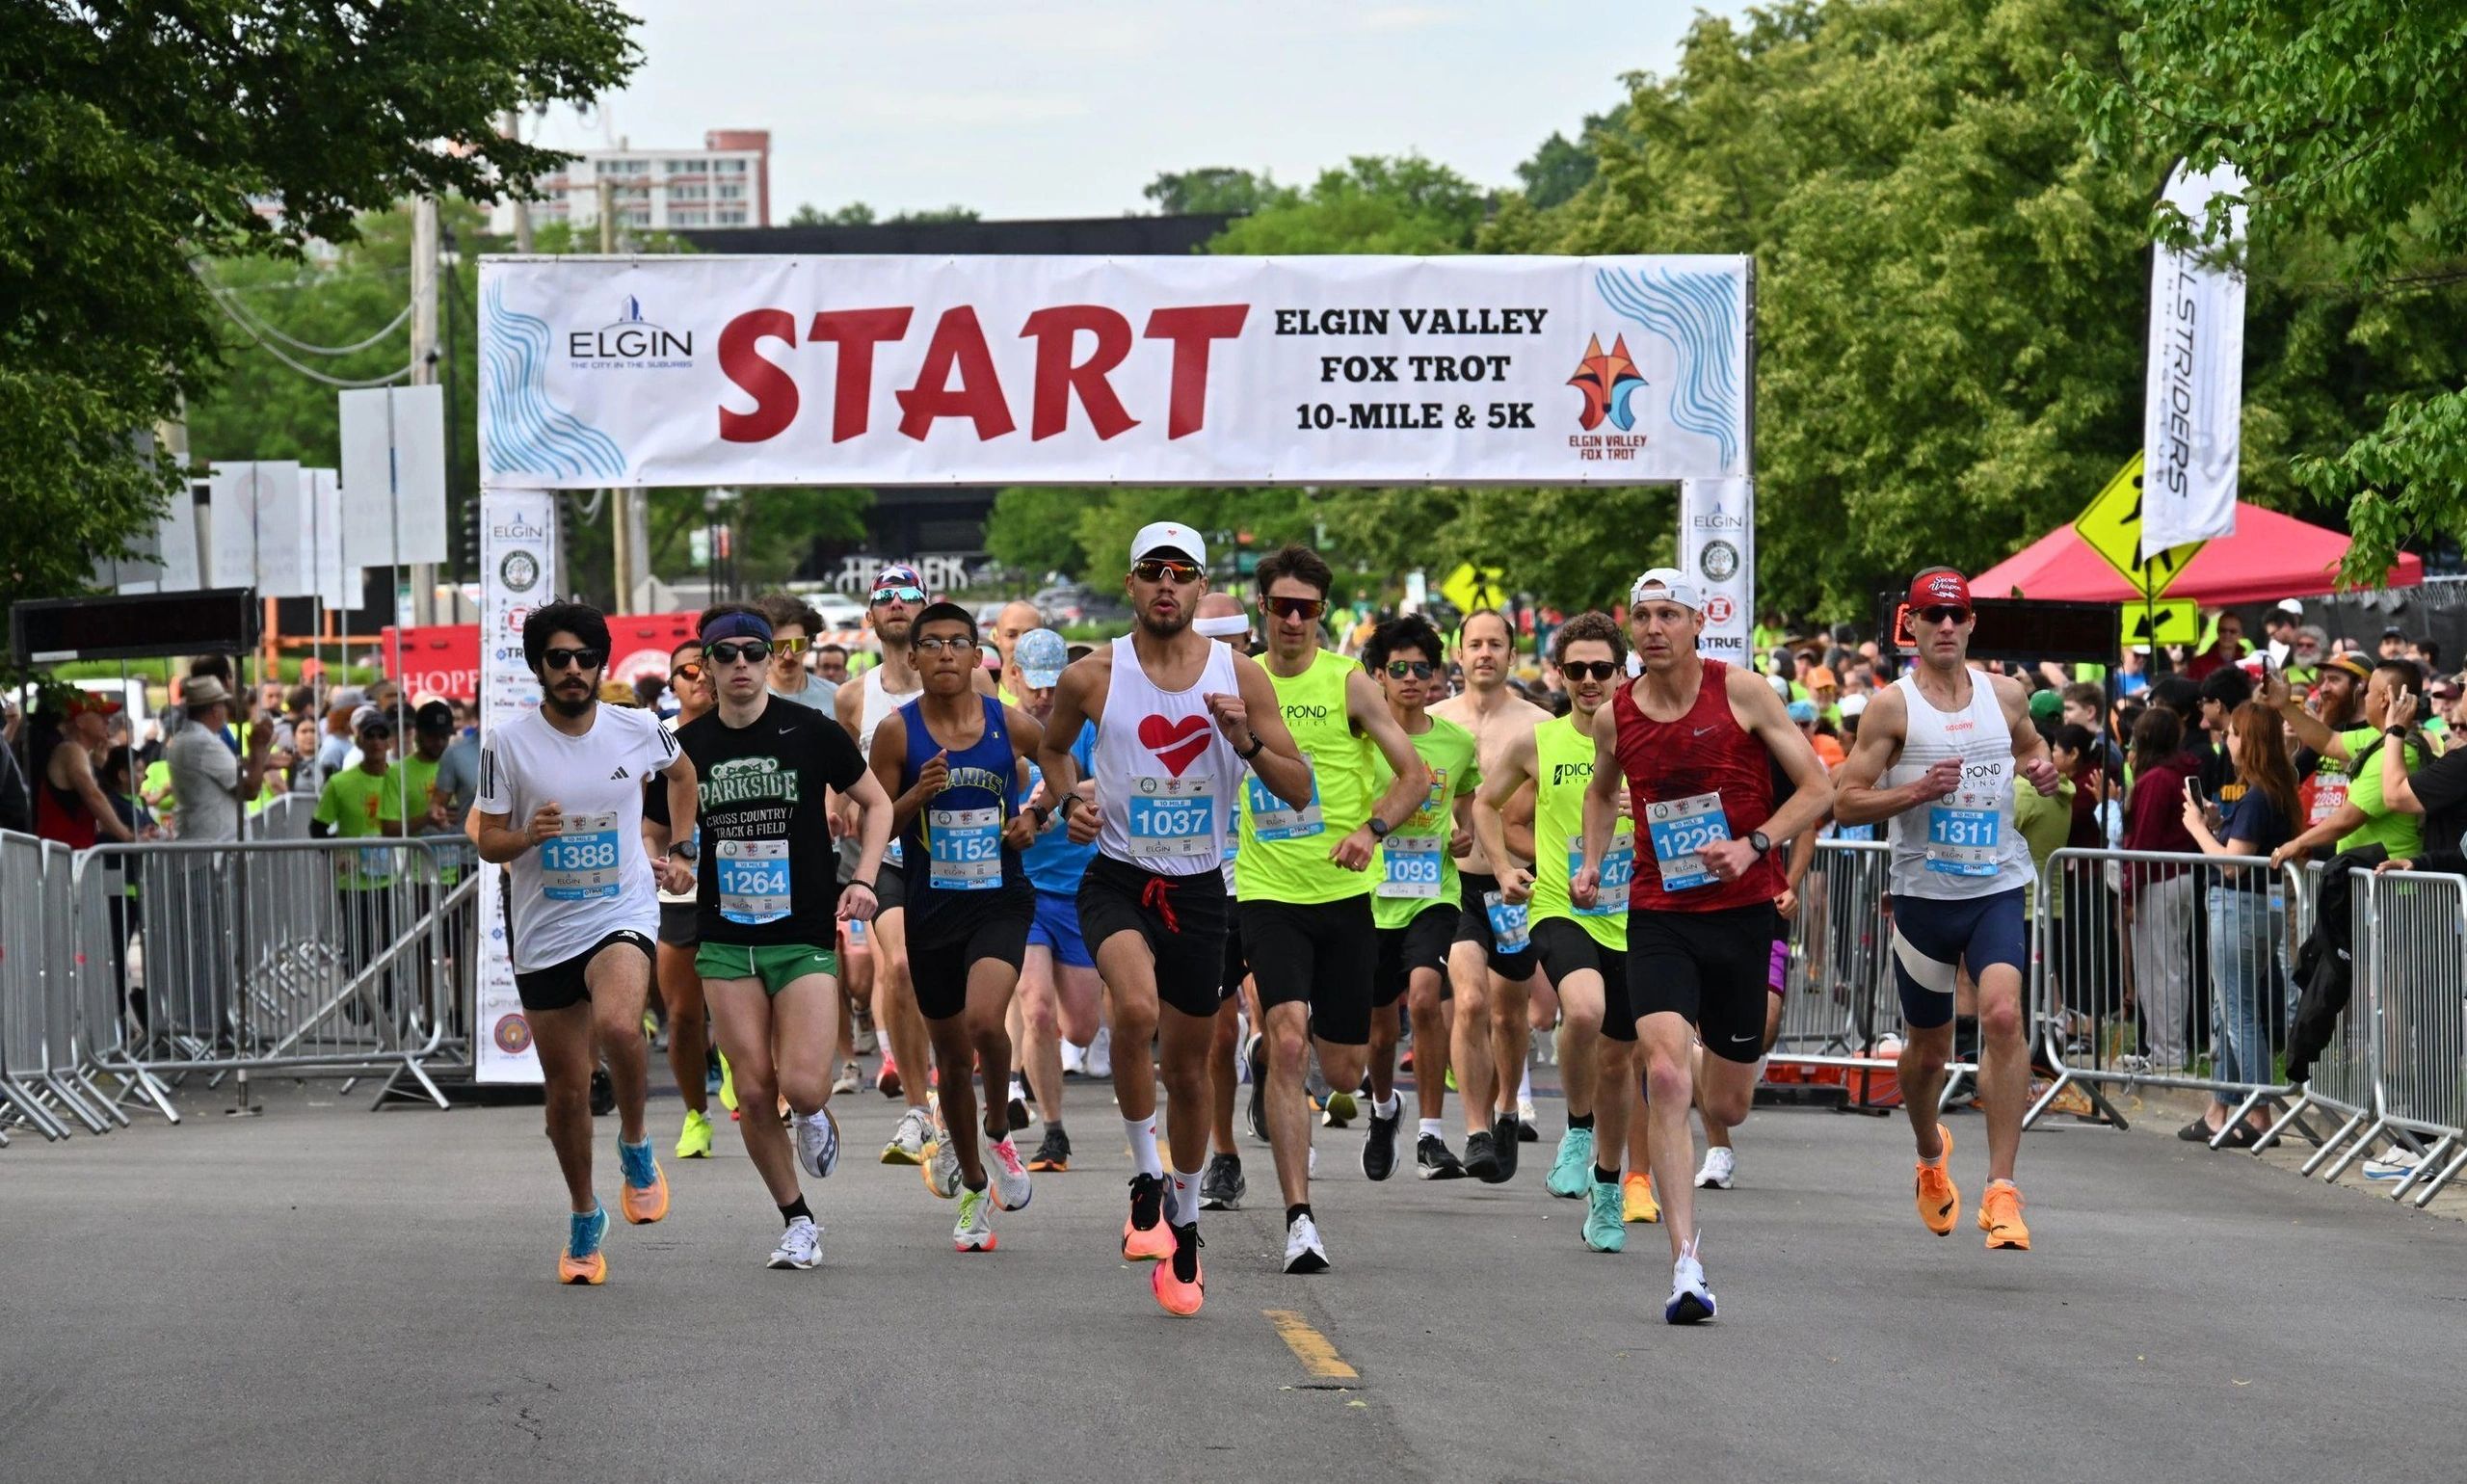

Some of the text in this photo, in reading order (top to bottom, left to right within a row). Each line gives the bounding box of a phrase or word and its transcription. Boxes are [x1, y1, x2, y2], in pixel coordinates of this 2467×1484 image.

[1274, 307, 1549, 335] ELGIN VALLEY
[569, 331, 693, 358] ELGIN
[591, 361, 611, 370] CITY
[1320, 355, 1512, 384] FOX TROT
[2166, 222, 2201, 498] LLSTRIDERS
[717, 304, 1251, 444] START
[1296, 402, 1536, 430] 10-MILE & 5K
[1568, 434, 1648, 448] ELGIN VALLEY
[1579, 448, 1637, 461] FOX TROT
[493, 526, 543, 539] ELGIN
[1694, 516, 1742, 528] ELGIN
[507, 647, 525, 658] TR
[1706, 637, 1742, 649] TRUE
[1287, 704, 1327, 719] POND
[933, 766, 1003, 796] ARKS
[1564, 762, 1596, 777] DICK
[1966, 763, 2002, 779] POND
[697, 771, 799, 813] PARKSIDE
[1962, 778, 1996, 789] CING
[706, 812, 738, 828] CROSS
[740, 808, 787, 824] COUNTRY
[1136, 808, 1208, 835] 1037
[713, 821, 786, 839] TRACK & FIELD
[1658, 823, 1727, 858] 1228
[1935, 819, 1994, 844] 1311
[547, 842, 615, 869] 1388
[936, 835, 997, 861] 1152
[723, 870, 787, 894] 1264
[1384, 860, 1438, 882] 1093
